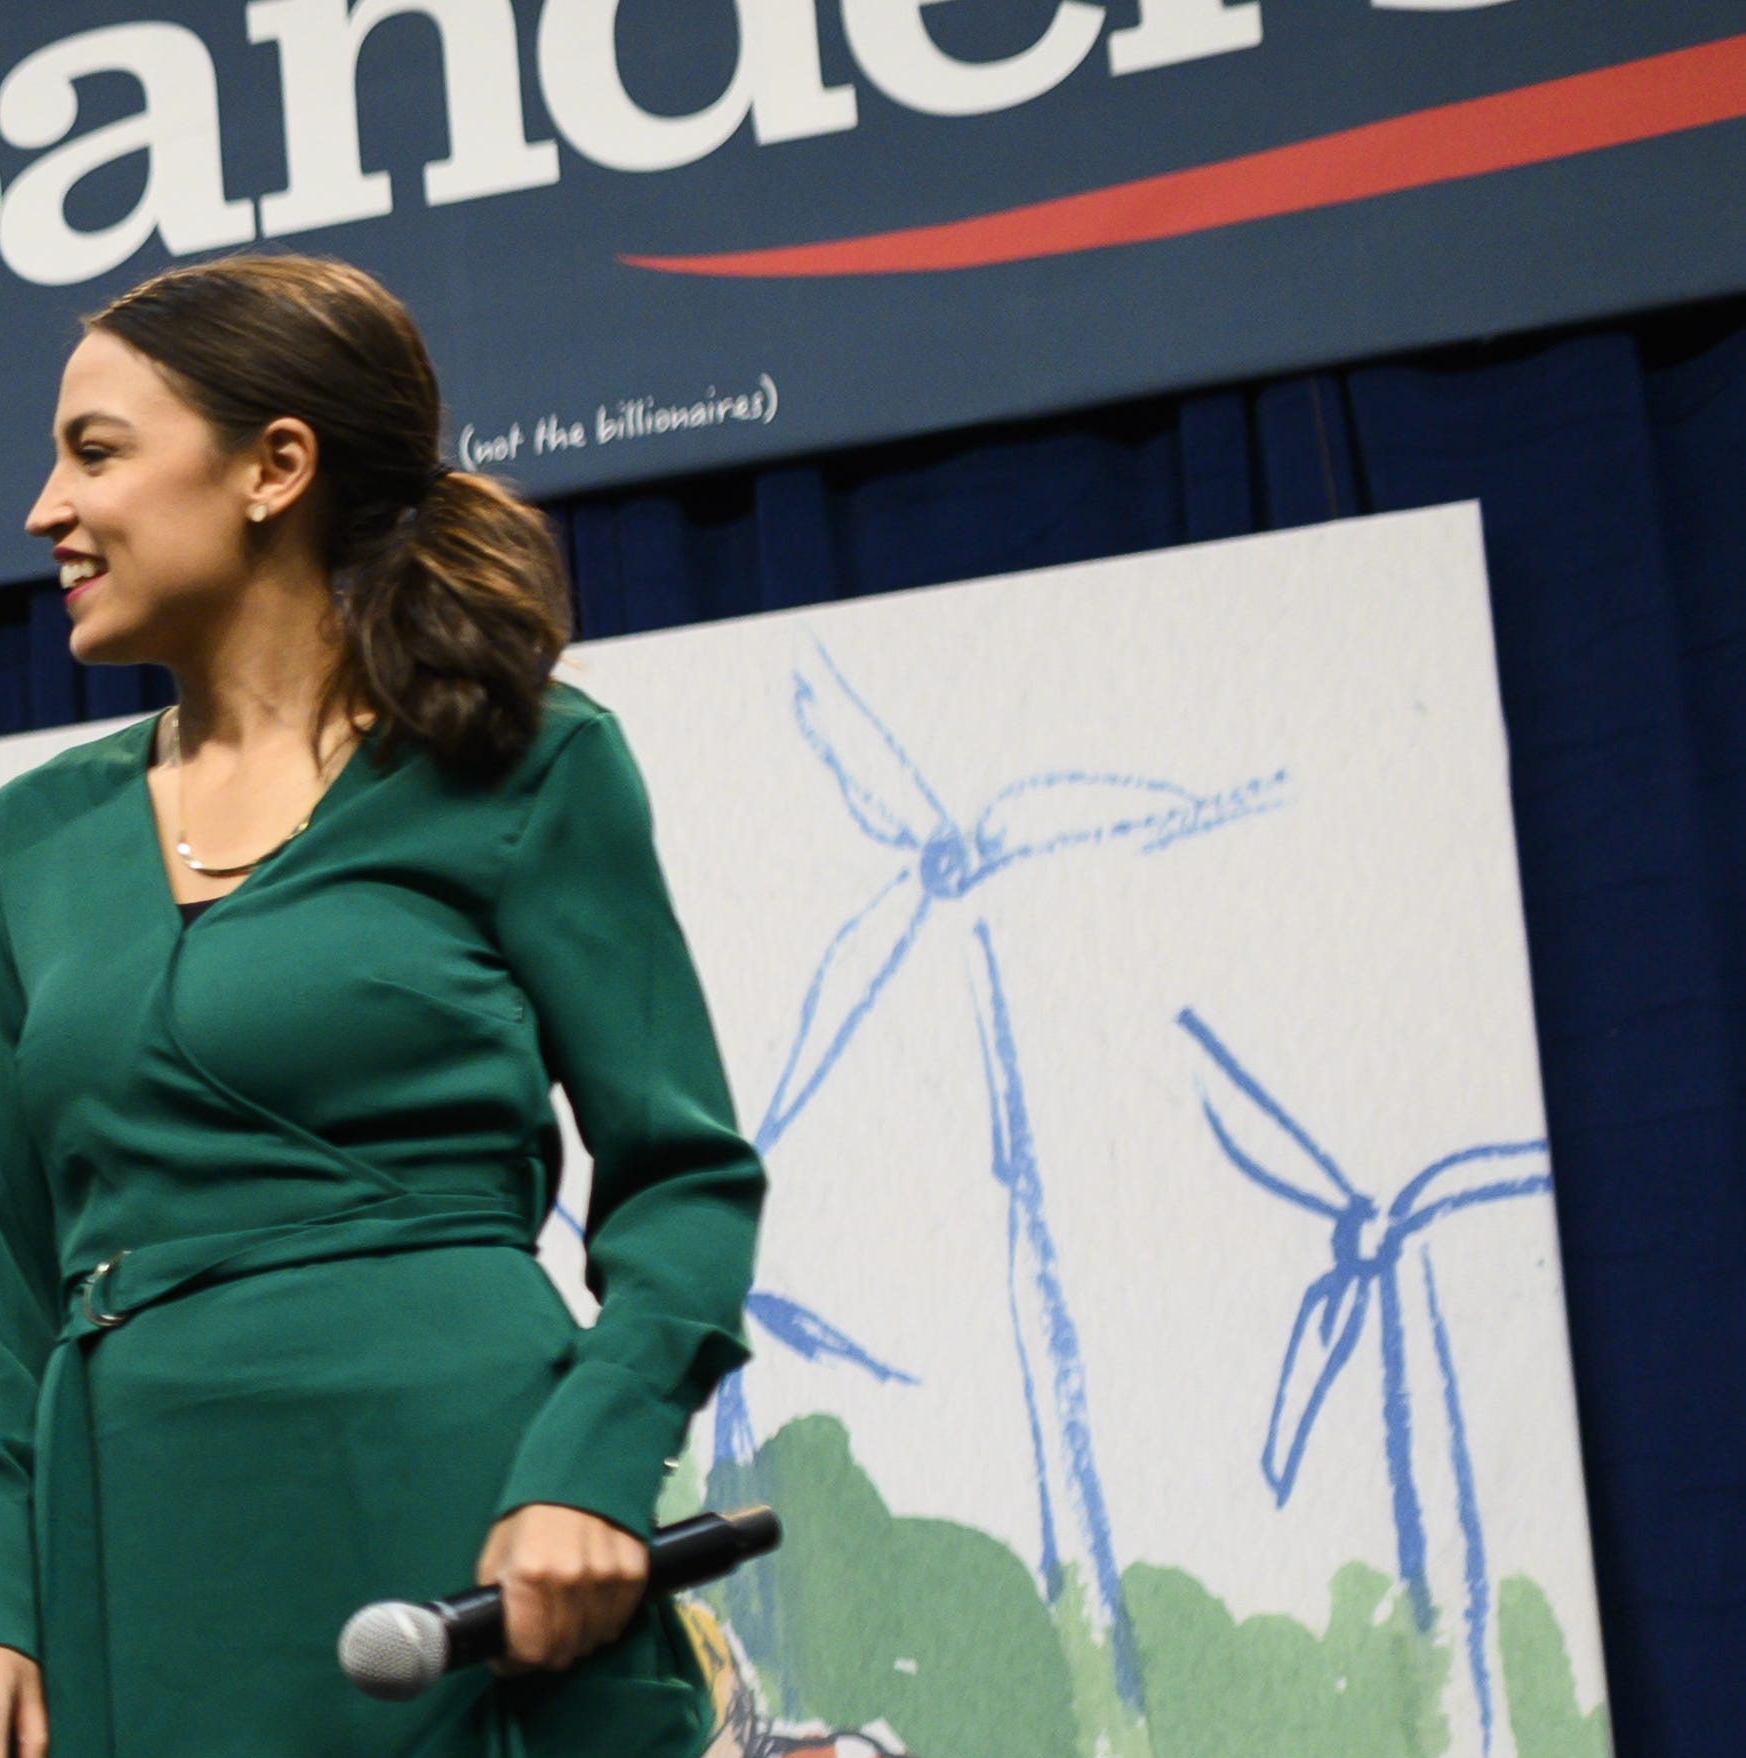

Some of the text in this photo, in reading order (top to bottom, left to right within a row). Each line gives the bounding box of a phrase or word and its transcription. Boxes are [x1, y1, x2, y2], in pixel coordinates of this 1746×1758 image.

[459, 373, 779, 472] (not the billionaires)
